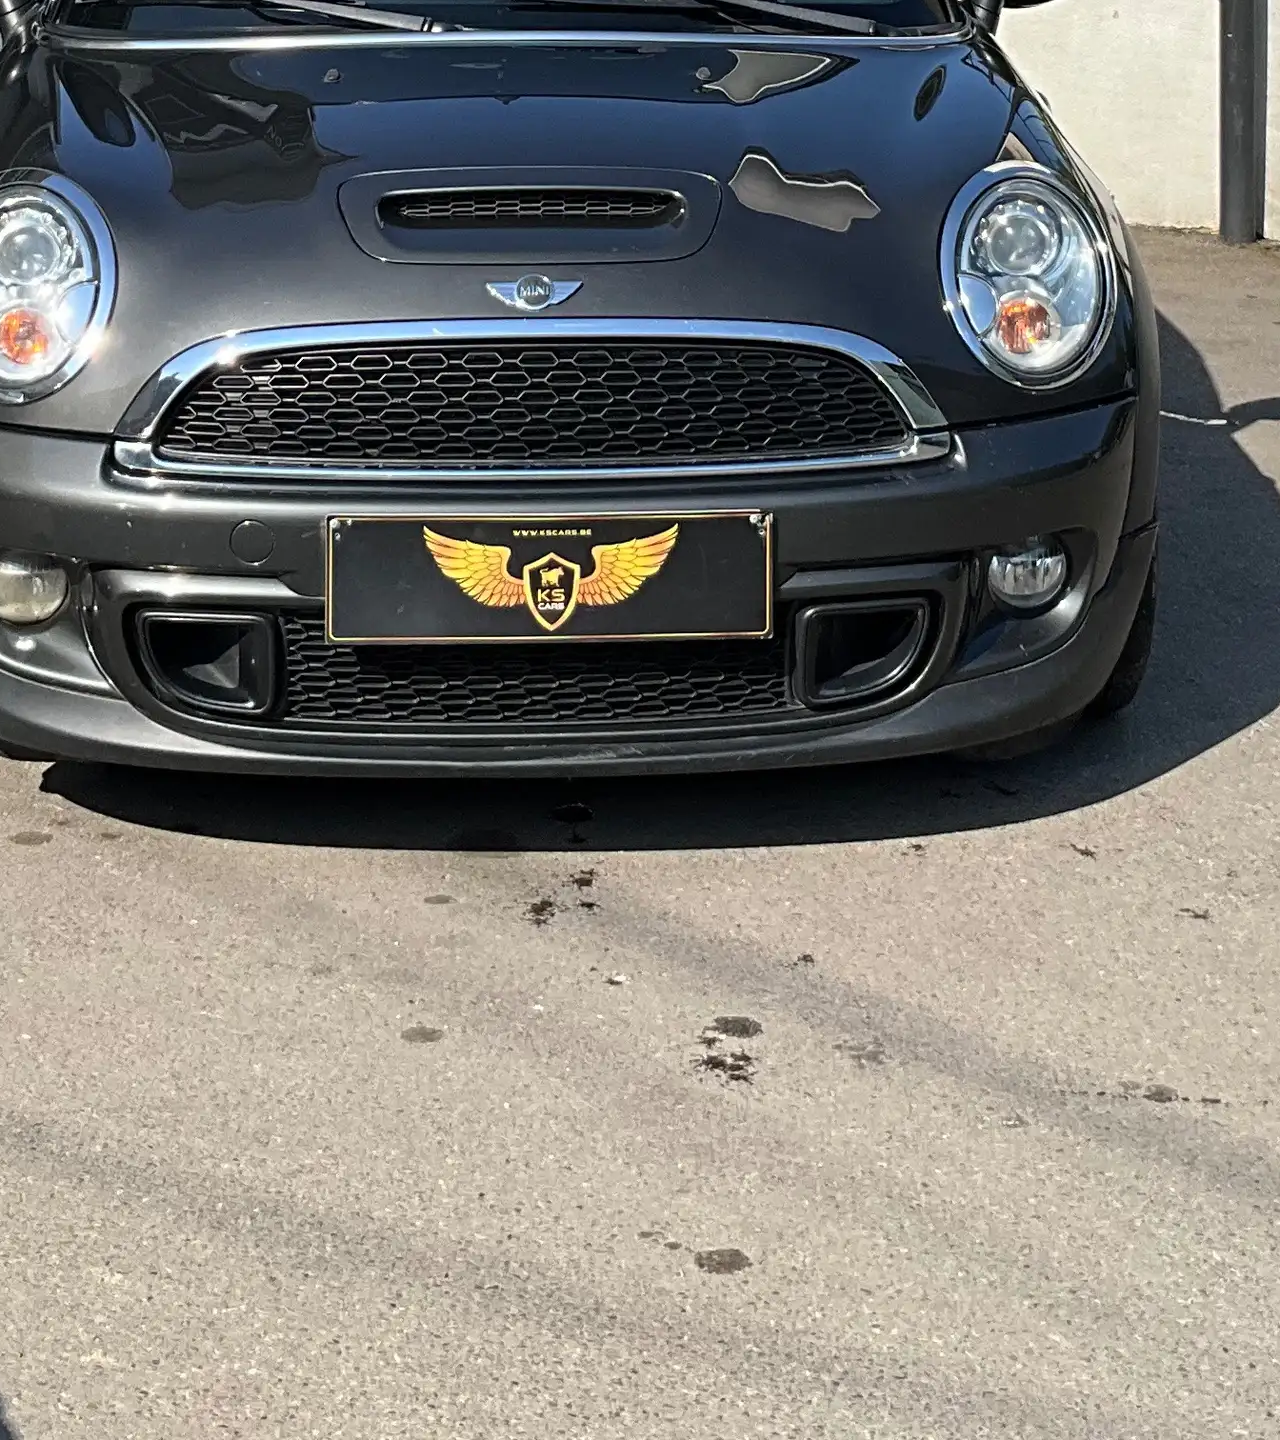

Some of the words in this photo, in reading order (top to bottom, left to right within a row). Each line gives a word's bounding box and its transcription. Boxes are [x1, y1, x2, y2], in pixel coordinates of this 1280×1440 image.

[520, 284, 550, 297] MINI
[537, 588, 566, 602] KS
[537, 602, 565, 611] CARS
